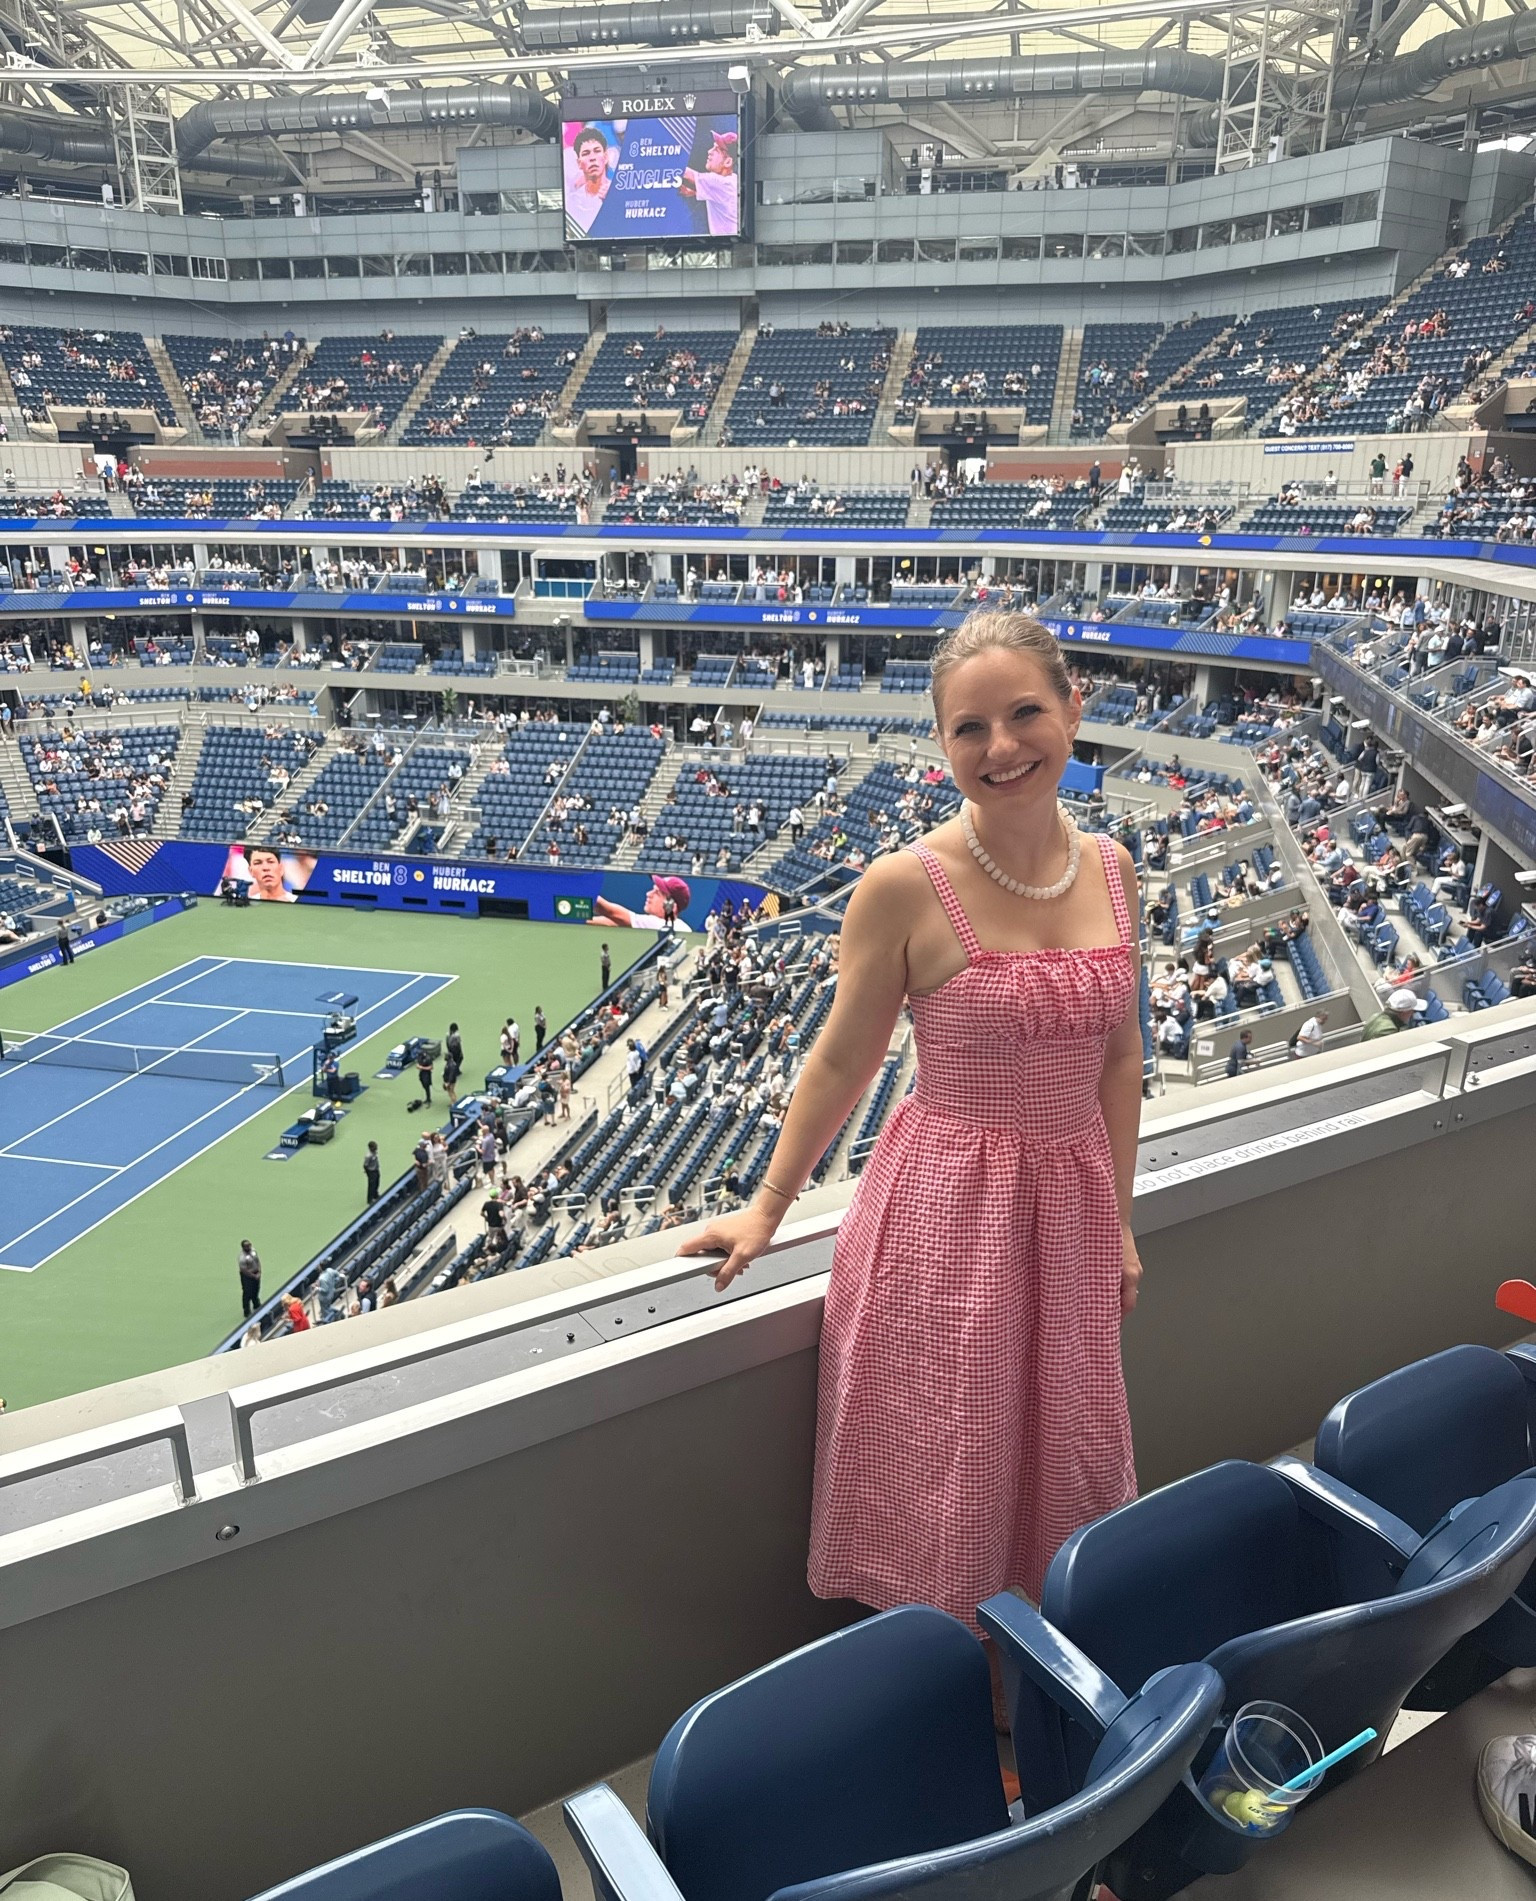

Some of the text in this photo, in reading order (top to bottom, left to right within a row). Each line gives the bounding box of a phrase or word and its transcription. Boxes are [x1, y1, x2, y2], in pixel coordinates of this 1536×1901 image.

[622, 98, 675, 112] ROLEX
[640, 138, 653, 146] BEN
[629, 142, 681, 157] 8 SHELTON
[616, 169, 682, 190] SINGLES
[625, 200, 650, 208] HUBERT
[625, 207, 667, 219] HURKACZ
[1264, 445, 1280, 453] GUEST
[373, 861, 390, 872] BEN
[432, 866, 467, 877] HUBERT
[333, 869, 391, 886] SHELTON
[393, 865, 408, 886] 8
[433, 876, 496, 894] HURKACZ
[1156, 1168, 1190, 1183] not
[1189, 1155, 1236, 1175] place
[1234, 1138, 1288, 1159] drinks
[1281, 1122, 1341, 1144] behind
[1336, 1113, 1367, 1128] rail
